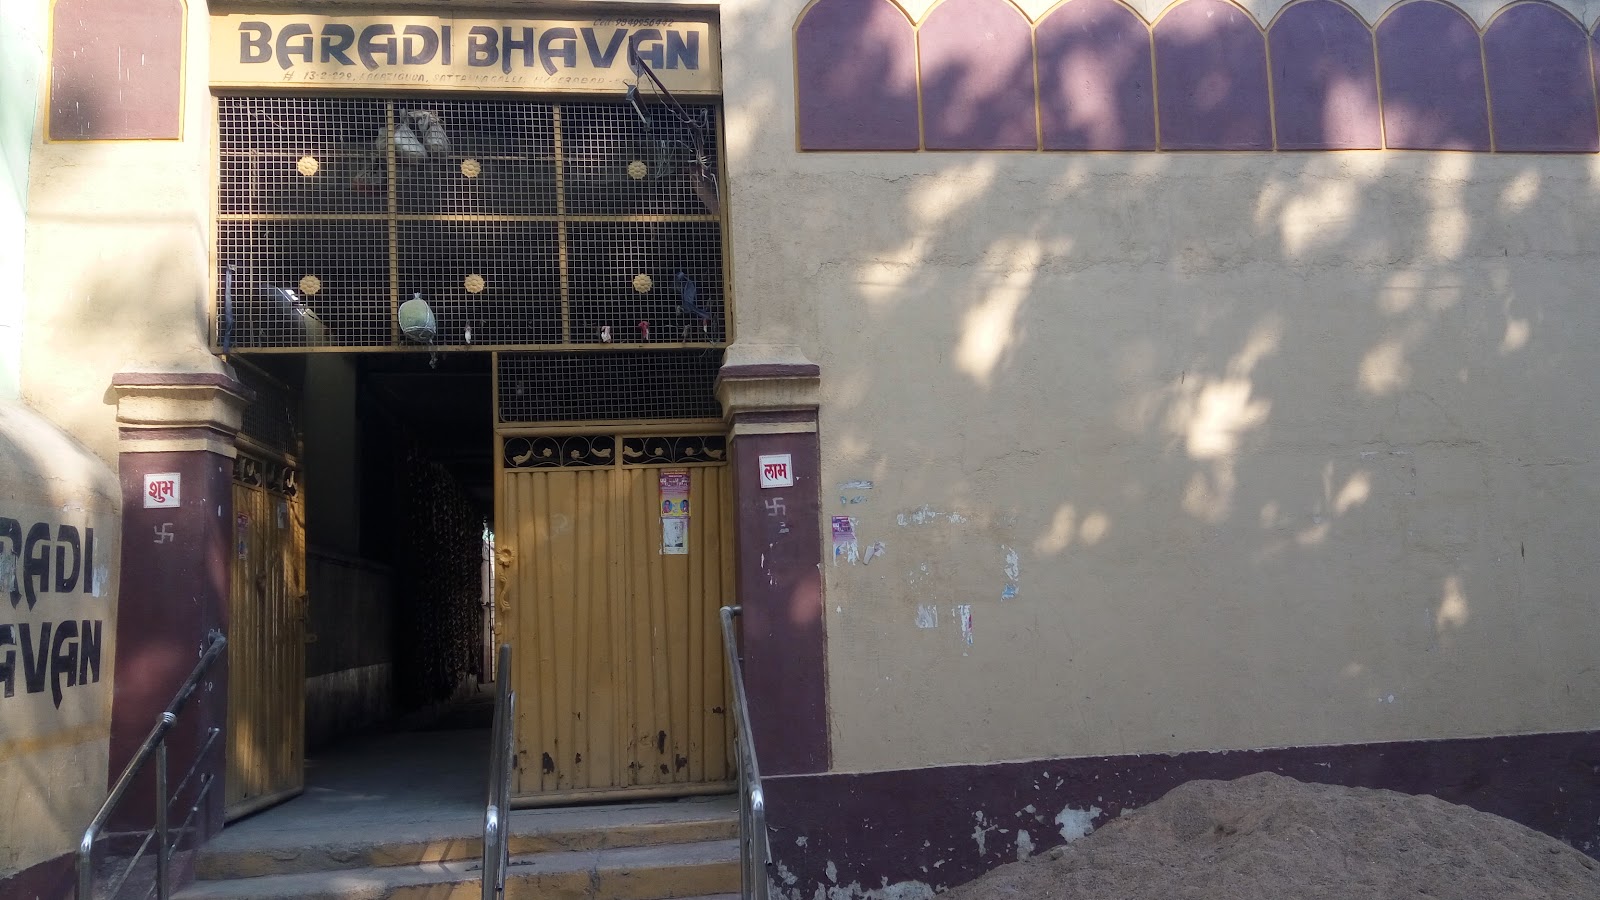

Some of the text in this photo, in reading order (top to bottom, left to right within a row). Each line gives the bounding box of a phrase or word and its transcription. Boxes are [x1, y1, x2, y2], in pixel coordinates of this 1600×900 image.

[238, 21, 699, 75] BARADI BHAVAN
[764, 463, 788, 481] लाभ
[148, 480, 175, 503] शुभ
